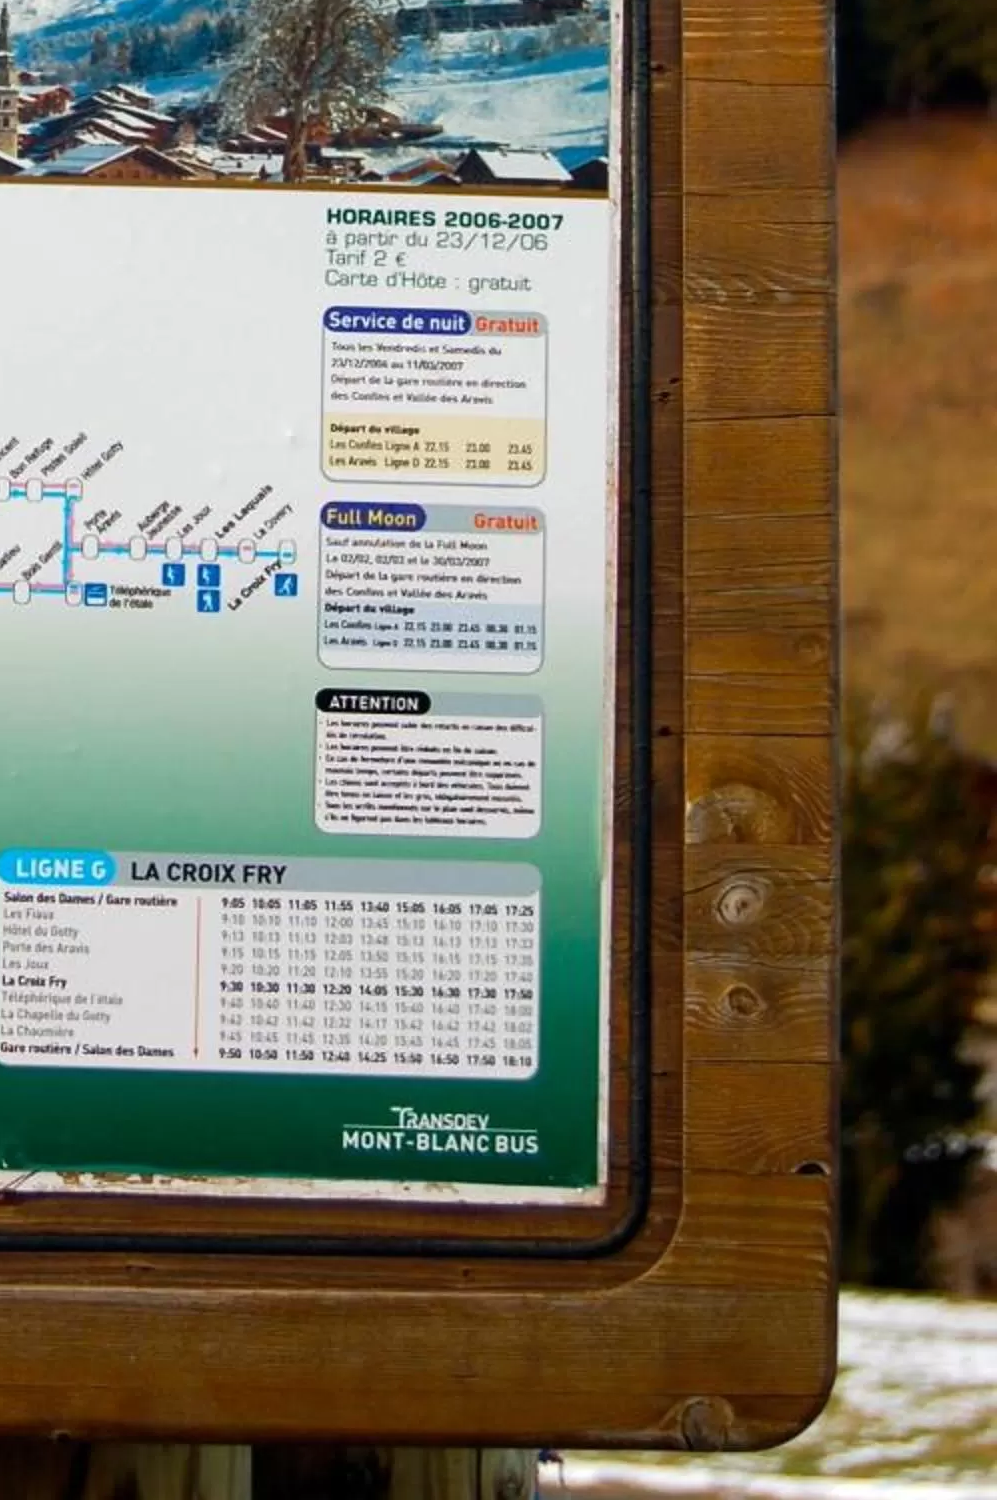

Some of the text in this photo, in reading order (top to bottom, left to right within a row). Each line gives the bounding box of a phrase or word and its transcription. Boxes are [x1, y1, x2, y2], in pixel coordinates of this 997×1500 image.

[327, 208, 563, 230] HORAIRES 2006-2007
[326, 230, 548, 251] à partir du 23/12/06
[326, 250, 407, 266] Tarif 2 €
[325, 270, 377, 287] Carte
[387, 271, 446, 289] d'Hôte
[469, 275, 531, 293] gratuit
[329, 312, 465, 331] Service de nuit
[475, 317, 539, 333] Gratuit
[369, 425, 381, 434] du
[327, 510, 416, 526] Full Moon
[474, 514, 539, 530] Gratuit
[215, 520, 234, 539] Les
[227, 560, 283, 611] La Croix Fry
[109, 599, 121, 608] de
[364, 605, 376, 613] du
[330, 696, 418, 711] ATTENTION
[16, 859, 106, 878] LIGNE G
[131, 862, 287, 884] LA CROIX FRY
[4, 892, 33, 903] Salon
[37, 893, 55, 903] des
[59, 893, 95, 904] Dames
[106, 894, 131, 905] Gare
[3, 908, 21, 919] Les
[34, 926, 47, 936] du
[51, 926, 78, 940] Gotty
[3, 941, 89, 954] Porte des Aravis
[3, 959, 21, 969] Les
[2, 975, 67, 989] La Croix Fry
[75, 994, 87, 1004] de
[1, 1009, 110, 1023] La Chapelle du Gotty
[1, 1026, 13, 1035] La
[1, 1042, 25, 1053] Gare
[82, 1044, 112, 1055] Salon
[115, 1045, 134, 1056] des
[138, 1046, 174, 1057] Dames
[390, 1107, 489, 1130] TRANSDEV
[342, 1131, 539, 1154] MONT-BLANC BUS
